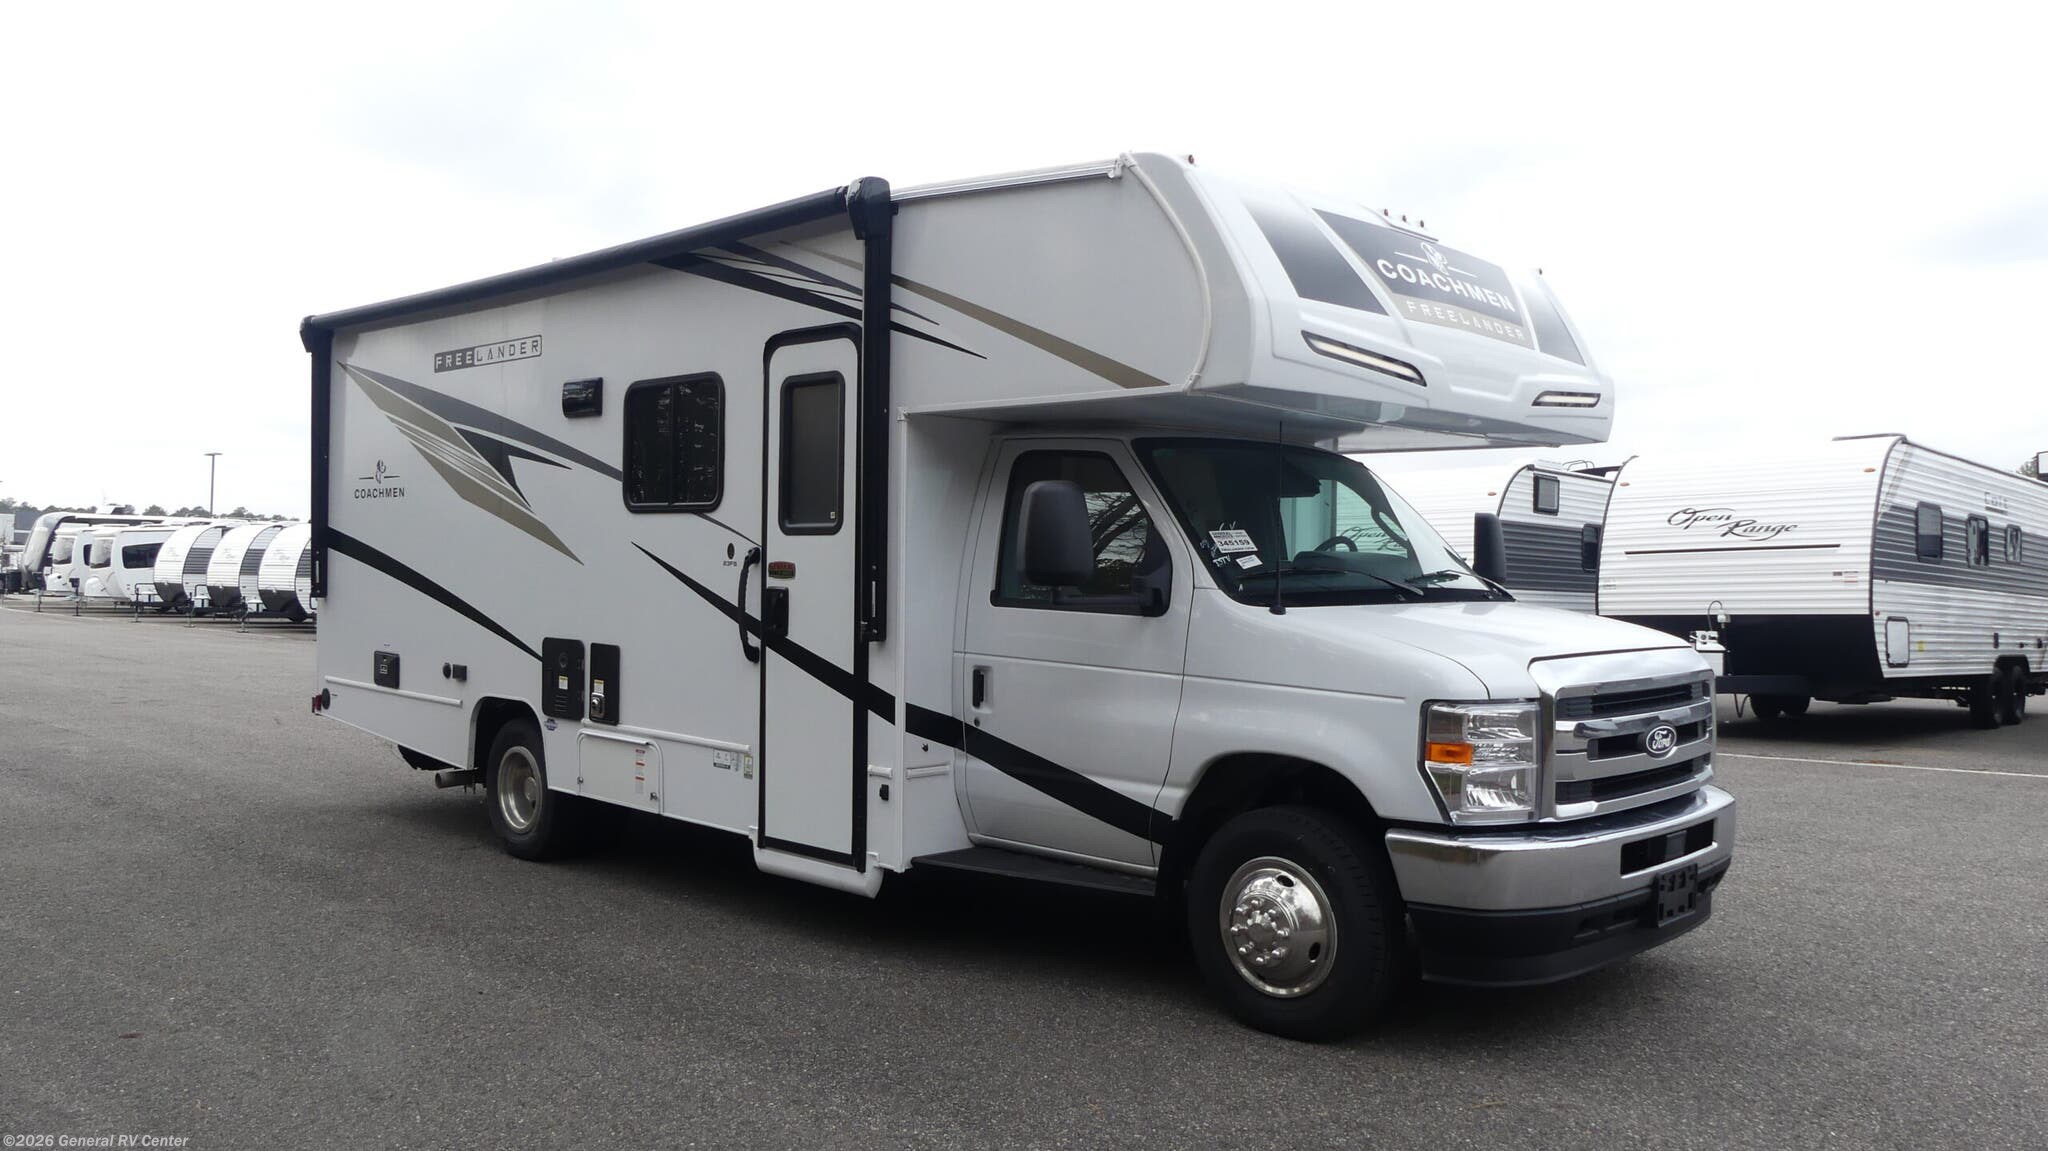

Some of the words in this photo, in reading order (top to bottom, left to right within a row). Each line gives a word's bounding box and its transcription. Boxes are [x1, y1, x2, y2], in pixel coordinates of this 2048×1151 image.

[1377, 259, 1515, 312] COACHMEN
[1406, 301, 1526, 340] FREELANDER
[435, 339, 539, 369] FREELANDER
[354, 487, 405, 499] COACHMEN
[1667, 507, 1737, 530] Open
[1716, 519, 1798, 541] Range
